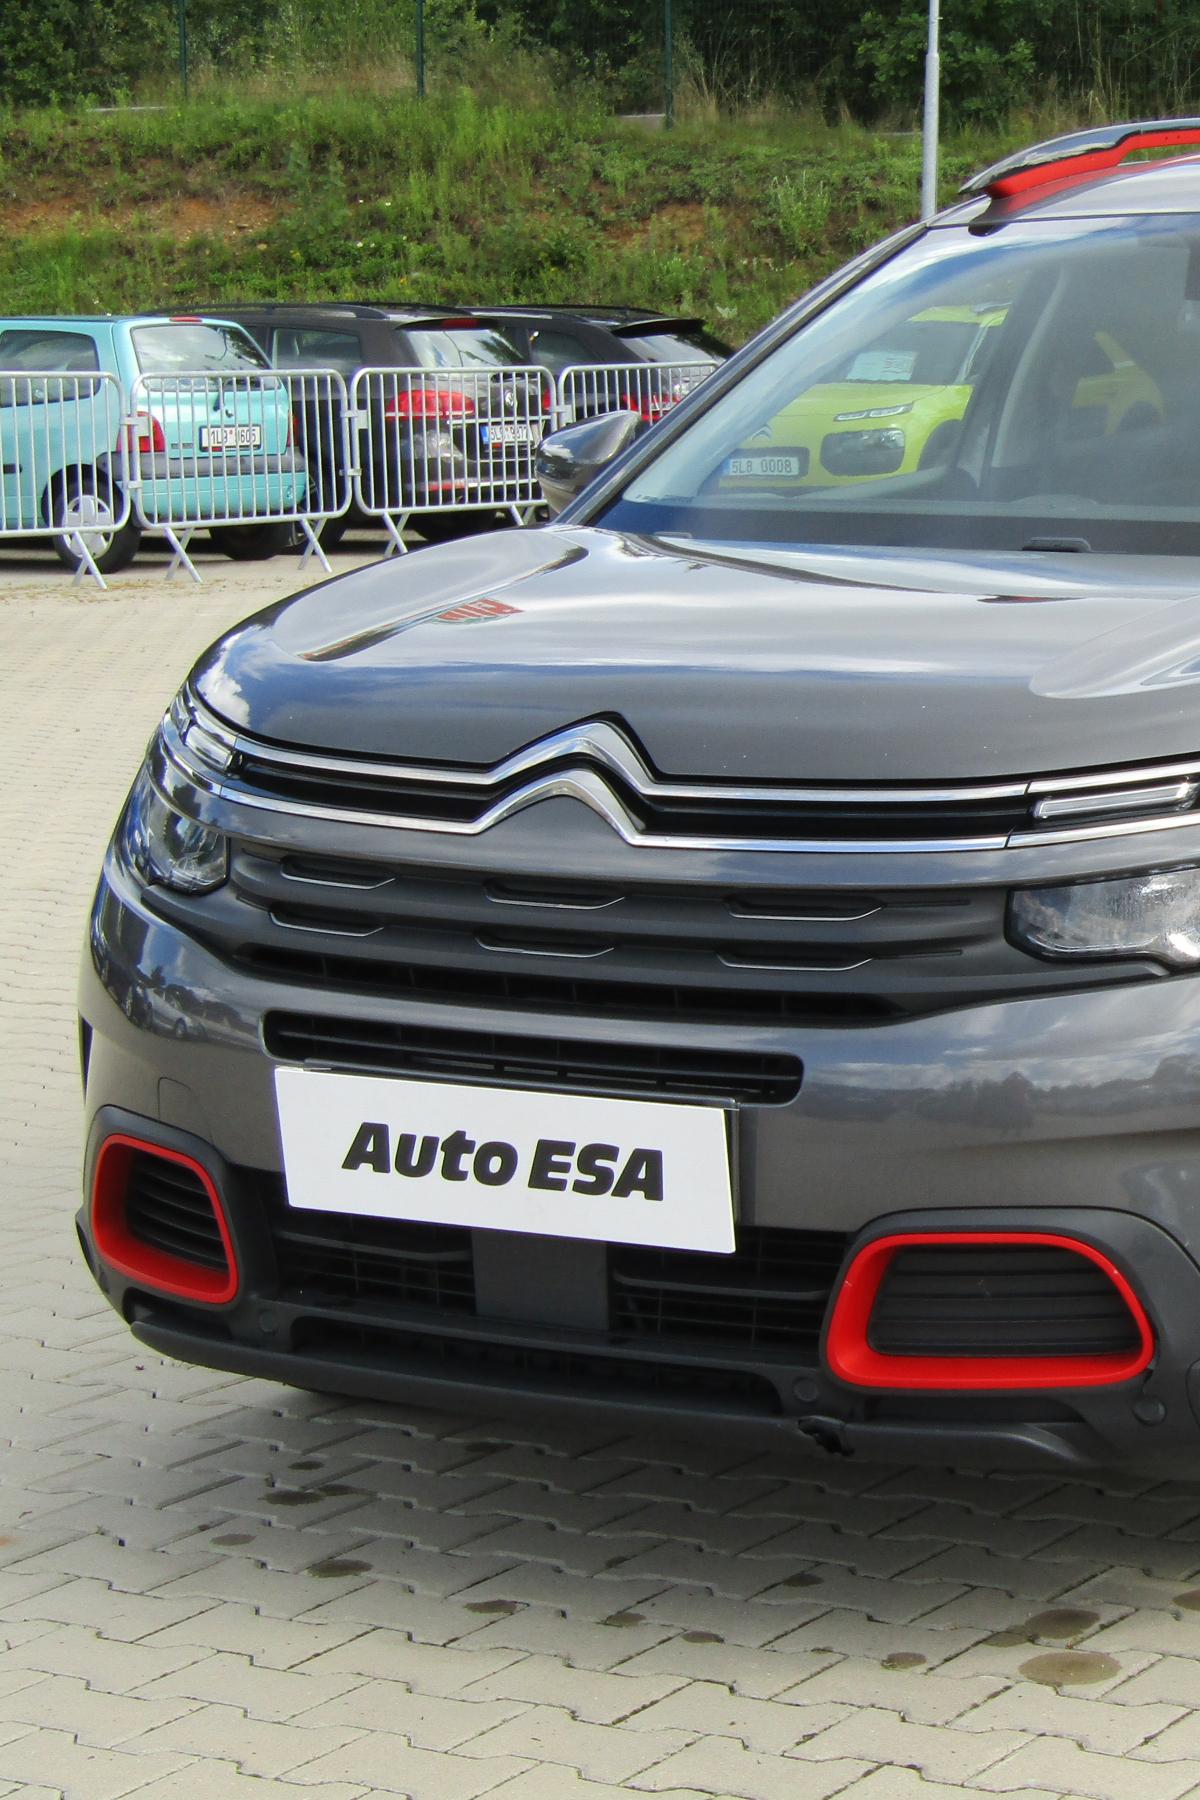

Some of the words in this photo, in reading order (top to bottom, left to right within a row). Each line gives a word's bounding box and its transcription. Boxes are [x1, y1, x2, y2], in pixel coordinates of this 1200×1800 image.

[732, 460, 753, 474] 5L8
[761, 459, 792, 473] 0008
[341, 1121, 519, 1186] Auto
[527, 1138, 664, 1201] ESA
